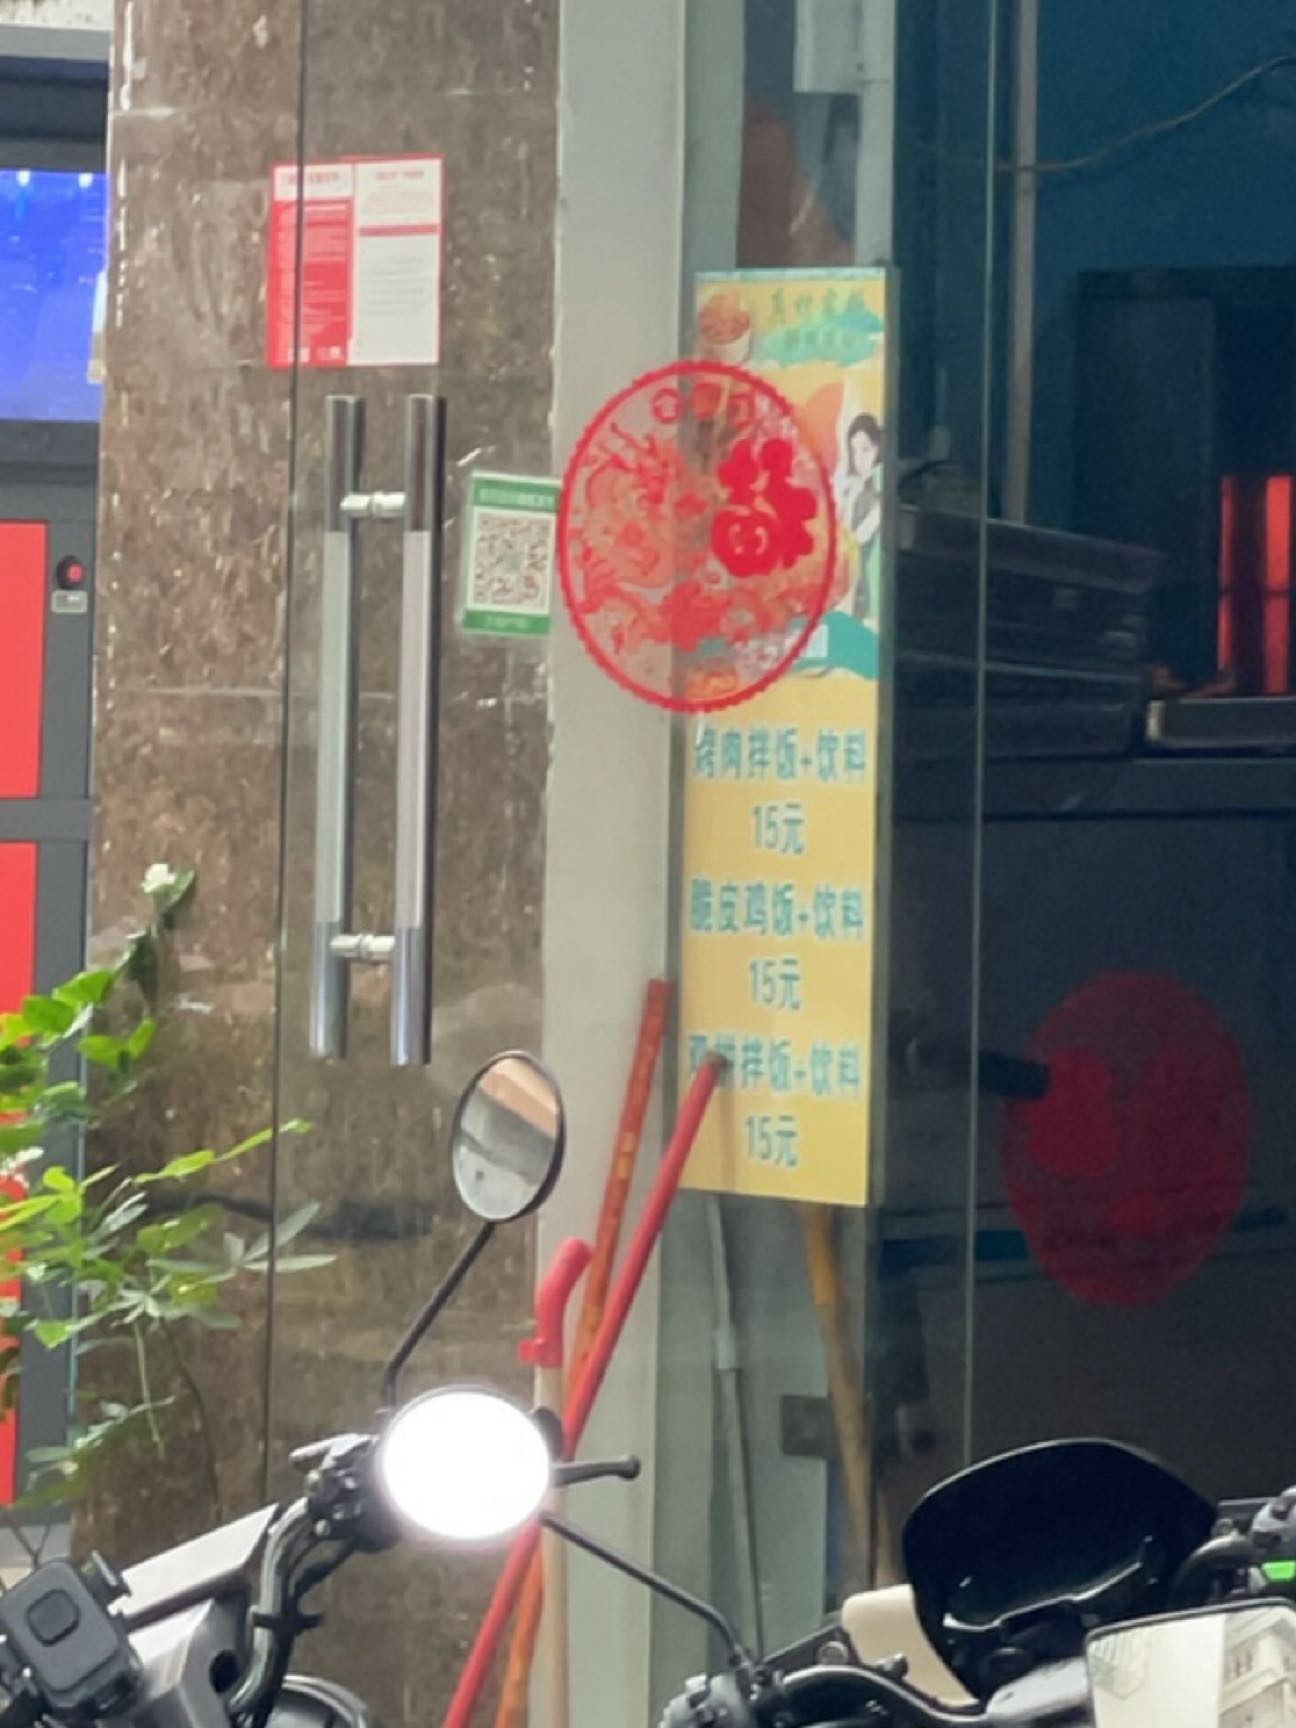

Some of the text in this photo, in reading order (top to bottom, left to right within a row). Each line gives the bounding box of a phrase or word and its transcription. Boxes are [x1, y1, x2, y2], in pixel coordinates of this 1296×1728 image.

[752, 802, 805, 855] 15元
[749, 958, 801, 1011] 15元
[746, 1115, 798, 1167] 15元
